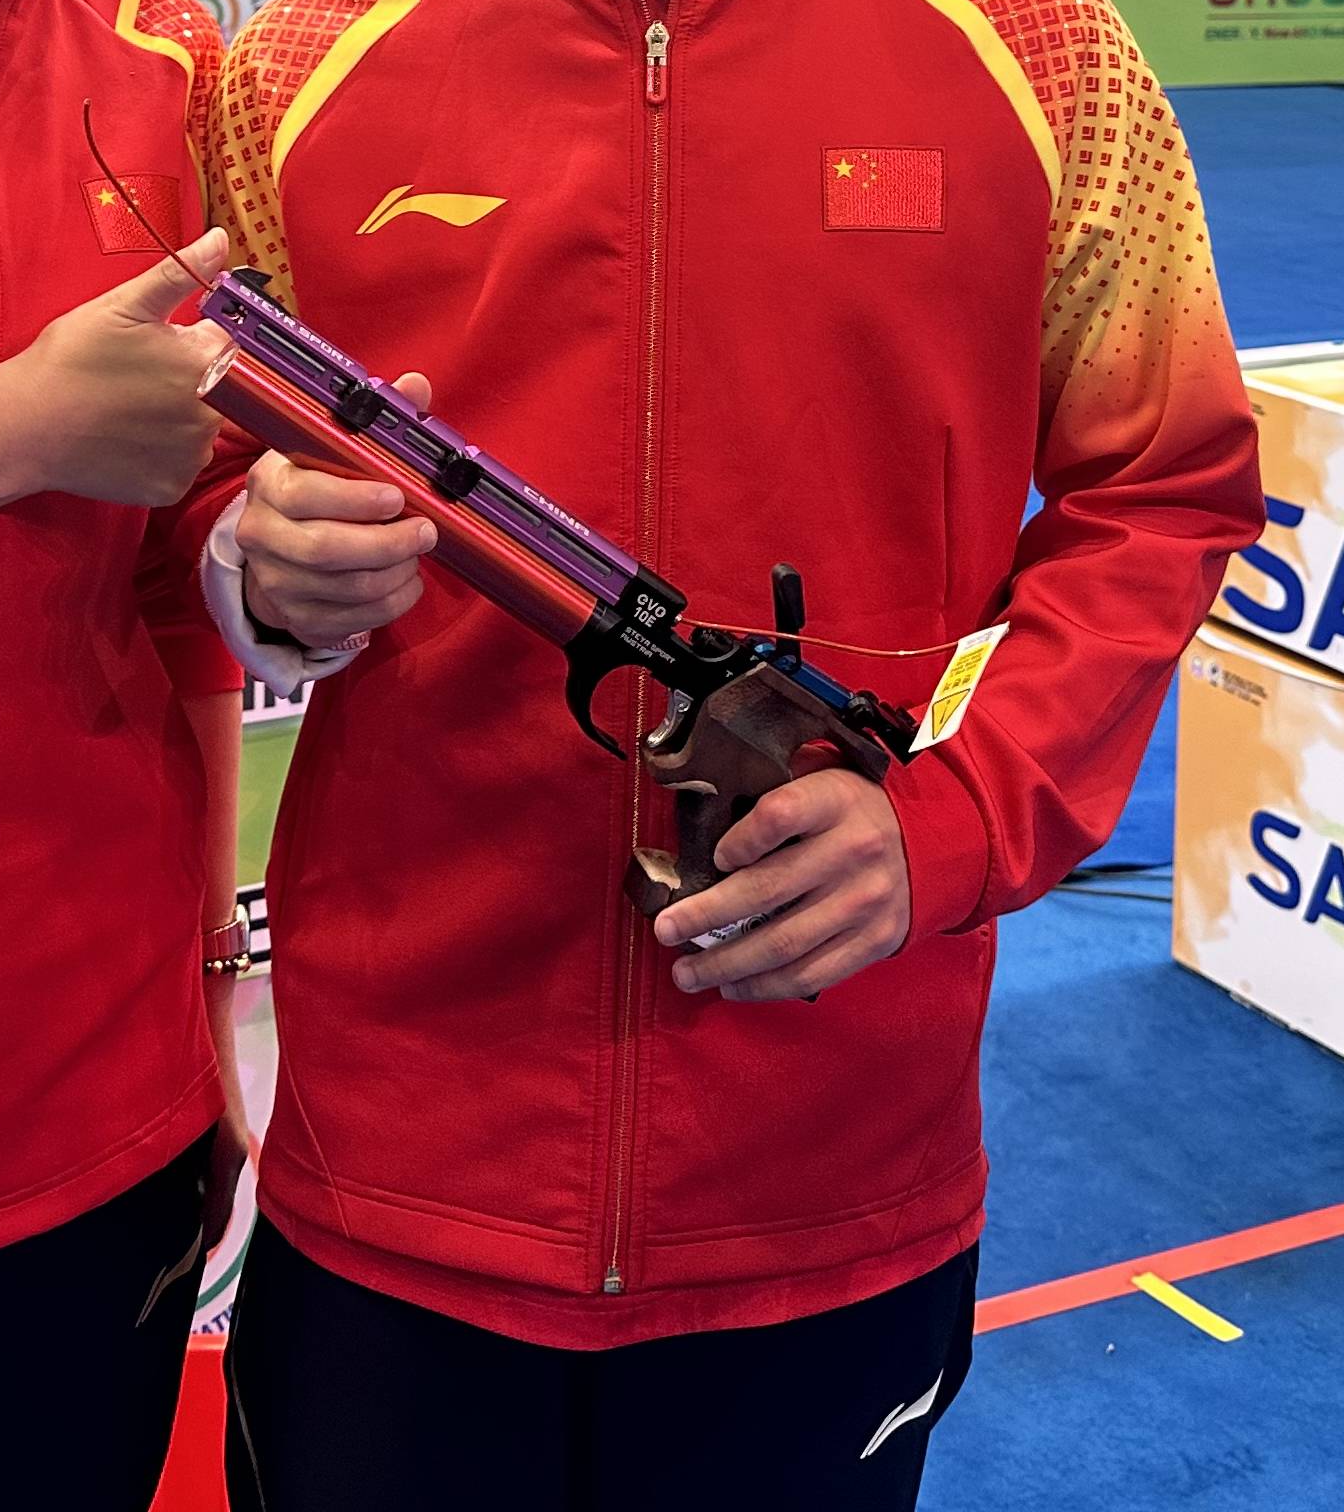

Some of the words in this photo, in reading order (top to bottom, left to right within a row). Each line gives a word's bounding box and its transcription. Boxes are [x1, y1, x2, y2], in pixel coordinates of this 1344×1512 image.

[238, 285, 297, 329] STEYR
[299, 326, 354, 368] SPORT
[523, 485, 591, 538] CHINA
[634, 606, 657, 628] 10E
[620, 632, 653, 658] AUSTRIA
[625, 626, 651, 648] STEYR
[650, 643, 676, 664] SPORT
